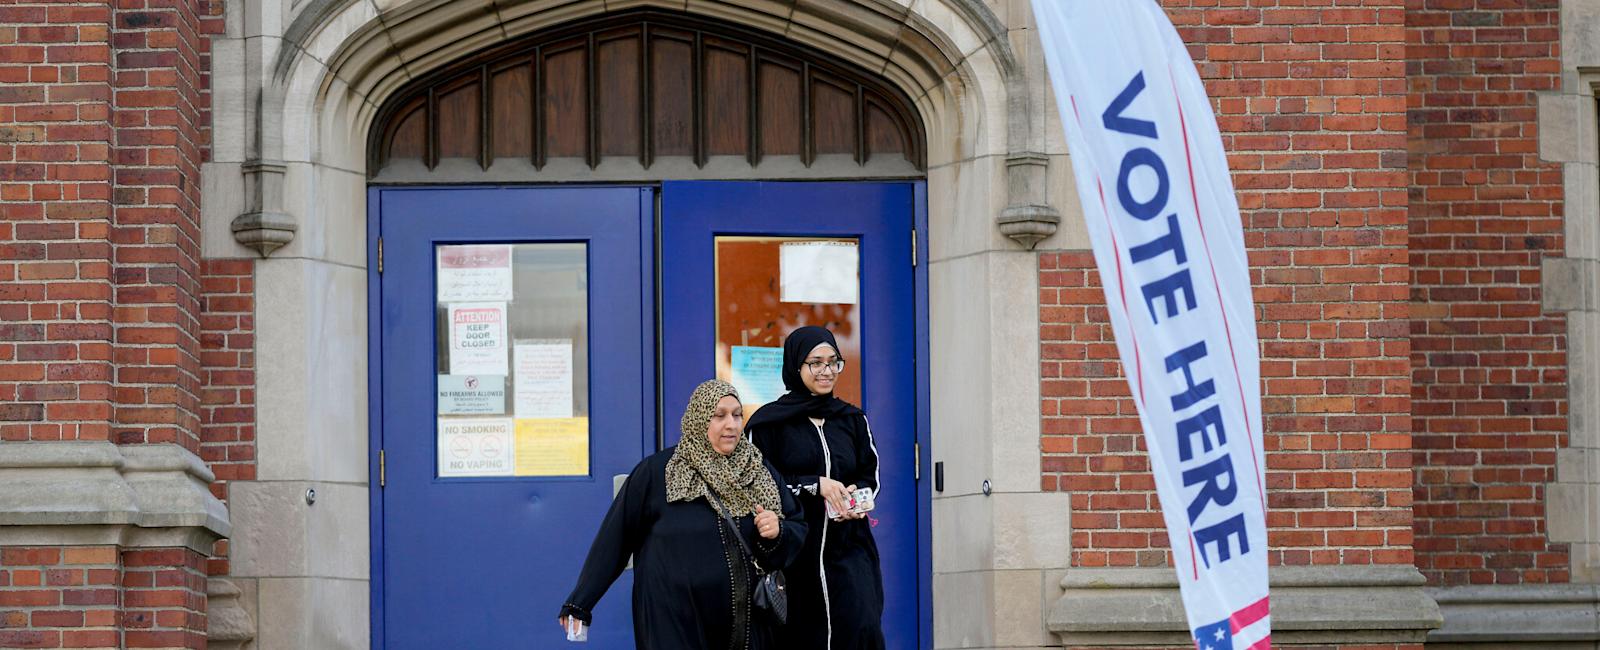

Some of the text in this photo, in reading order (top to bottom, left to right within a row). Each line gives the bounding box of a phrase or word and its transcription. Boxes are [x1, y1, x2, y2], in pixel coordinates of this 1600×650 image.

[455, 311, 501, 322] ATTENTION
[1102, 70, 1250, 570] VOTE HERE
[461, 340, 495, 348] CLOSED
[445, 424, 506, 434] NO SMOKING
[450, 459, 503, 470] NO VAPING
